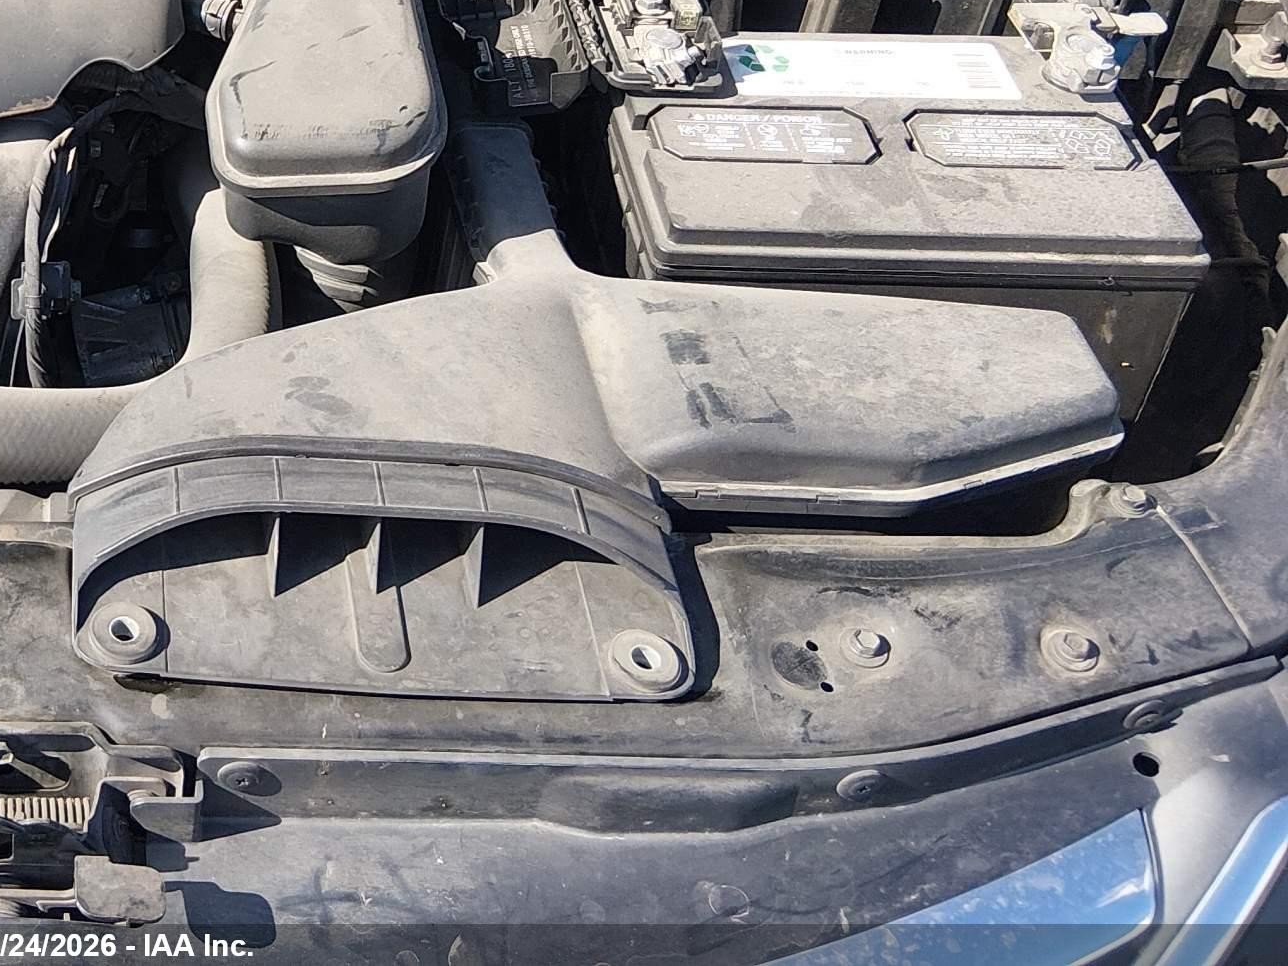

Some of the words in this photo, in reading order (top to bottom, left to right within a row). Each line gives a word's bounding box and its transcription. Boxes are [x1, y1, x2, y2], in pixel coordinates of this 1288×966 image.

[508, 81, 525, 99] ALT
[706, 114, 761, 122] DANGER
[772, 115, 823, 123] POISON
